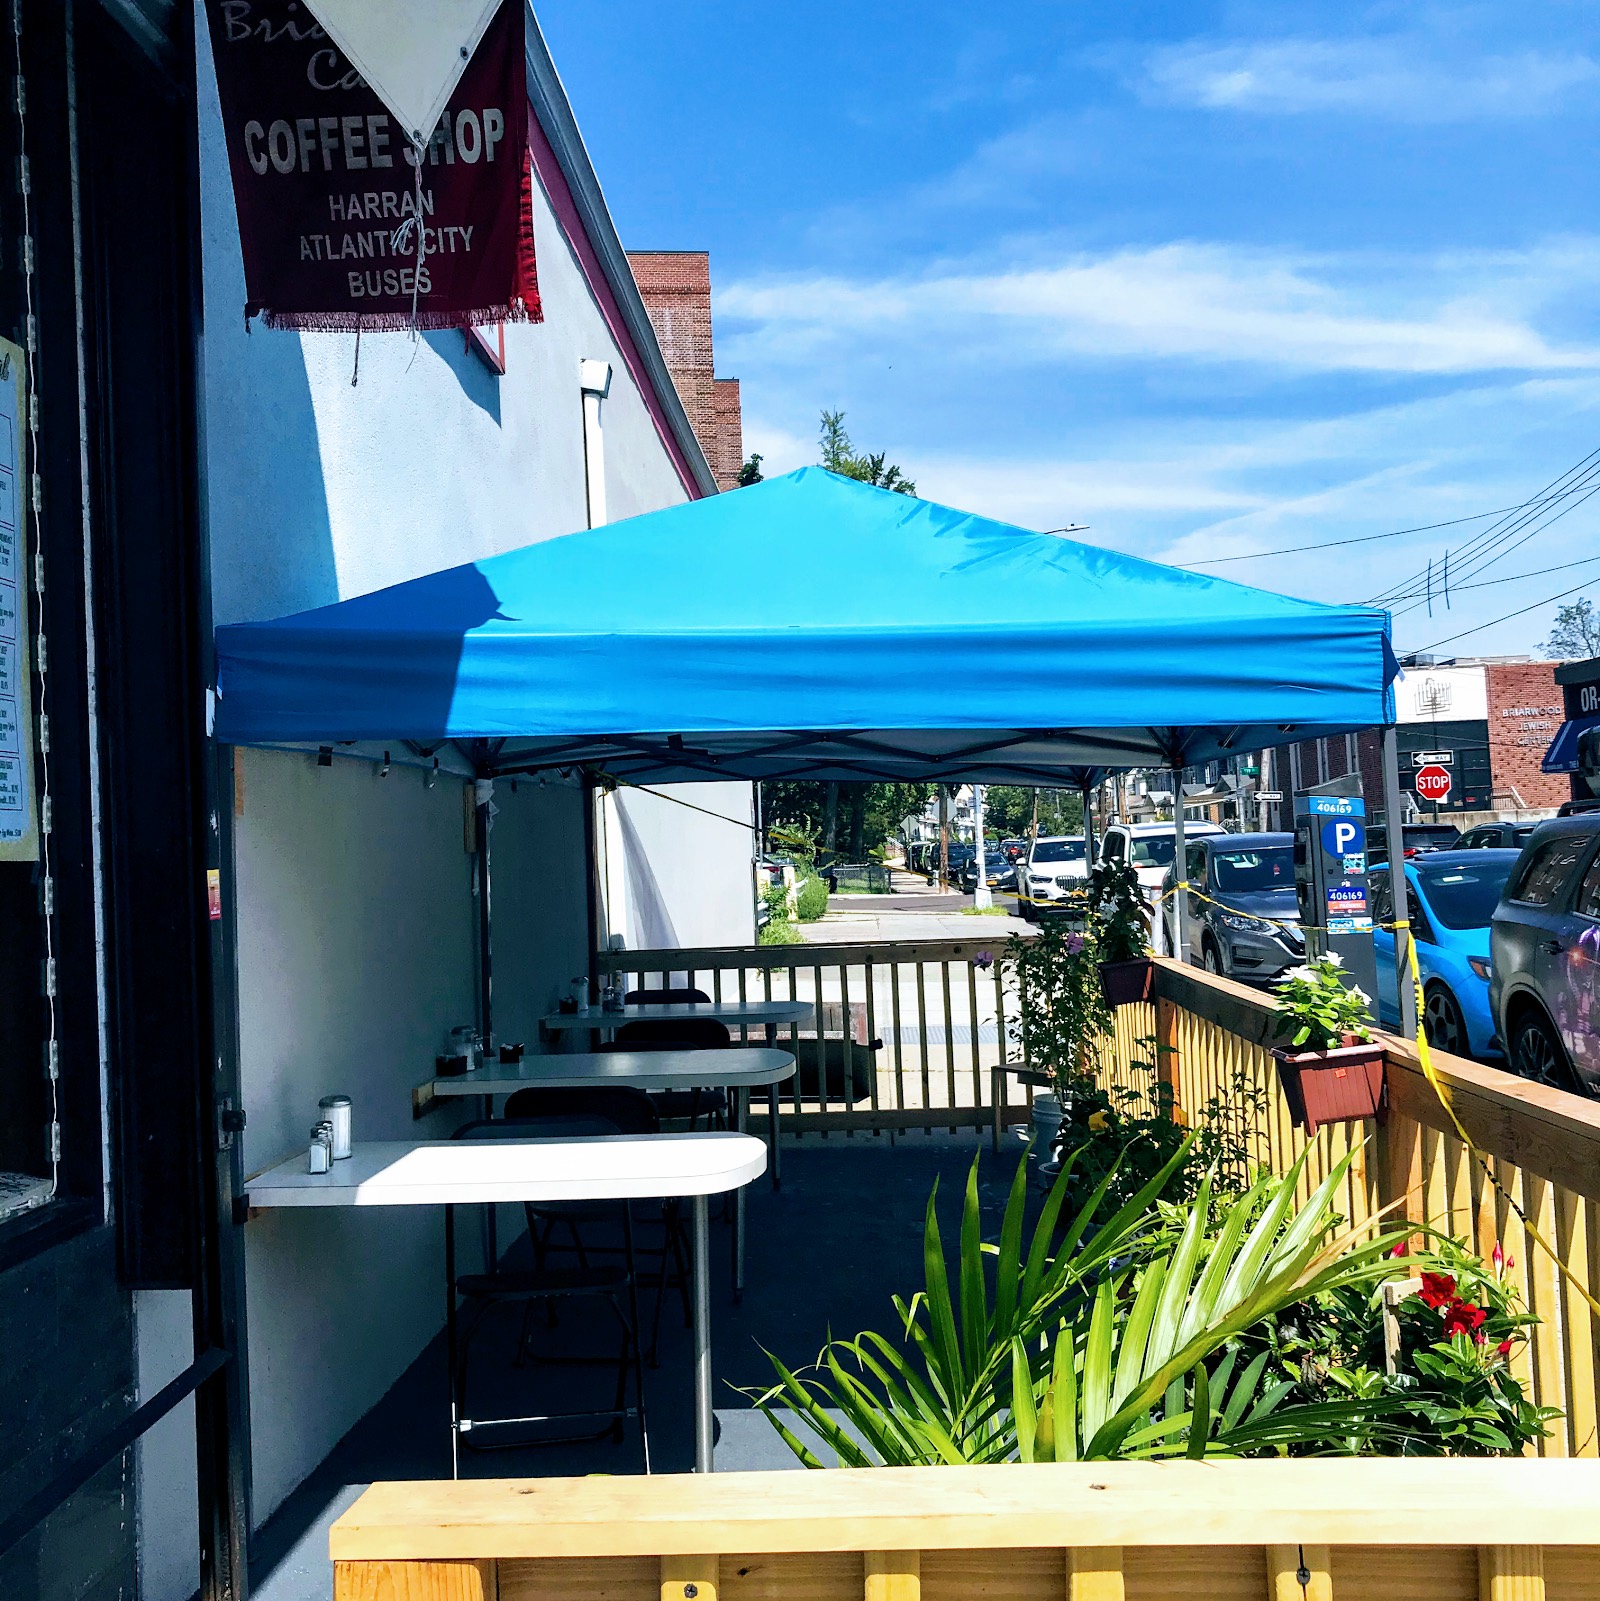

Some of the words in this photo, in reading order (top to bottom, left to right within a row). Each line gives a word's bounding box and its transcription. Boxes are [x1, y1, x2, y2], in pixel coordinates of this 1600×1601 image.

[244, 114, 394, 175] COFFEE
[328, 189, 434, 221] HARRAN
[300, 229, 414, 261] ATLANTIC
[423, 225, 474, 254] CITY
[348, 267, 432, 297] BUSES
[1502, 706, 1561, 717] BRIARWOOD
[1518, 721, 1551, 731] JEWISH
[1517, 735, 1554, 745] CENTER
[1418, 775, 1448, 789] STOP
[1317, 803, 1352, 814] 406169
[1335, 822, 1356, 854] P
[1329, 891, 1363, 901] 406169
